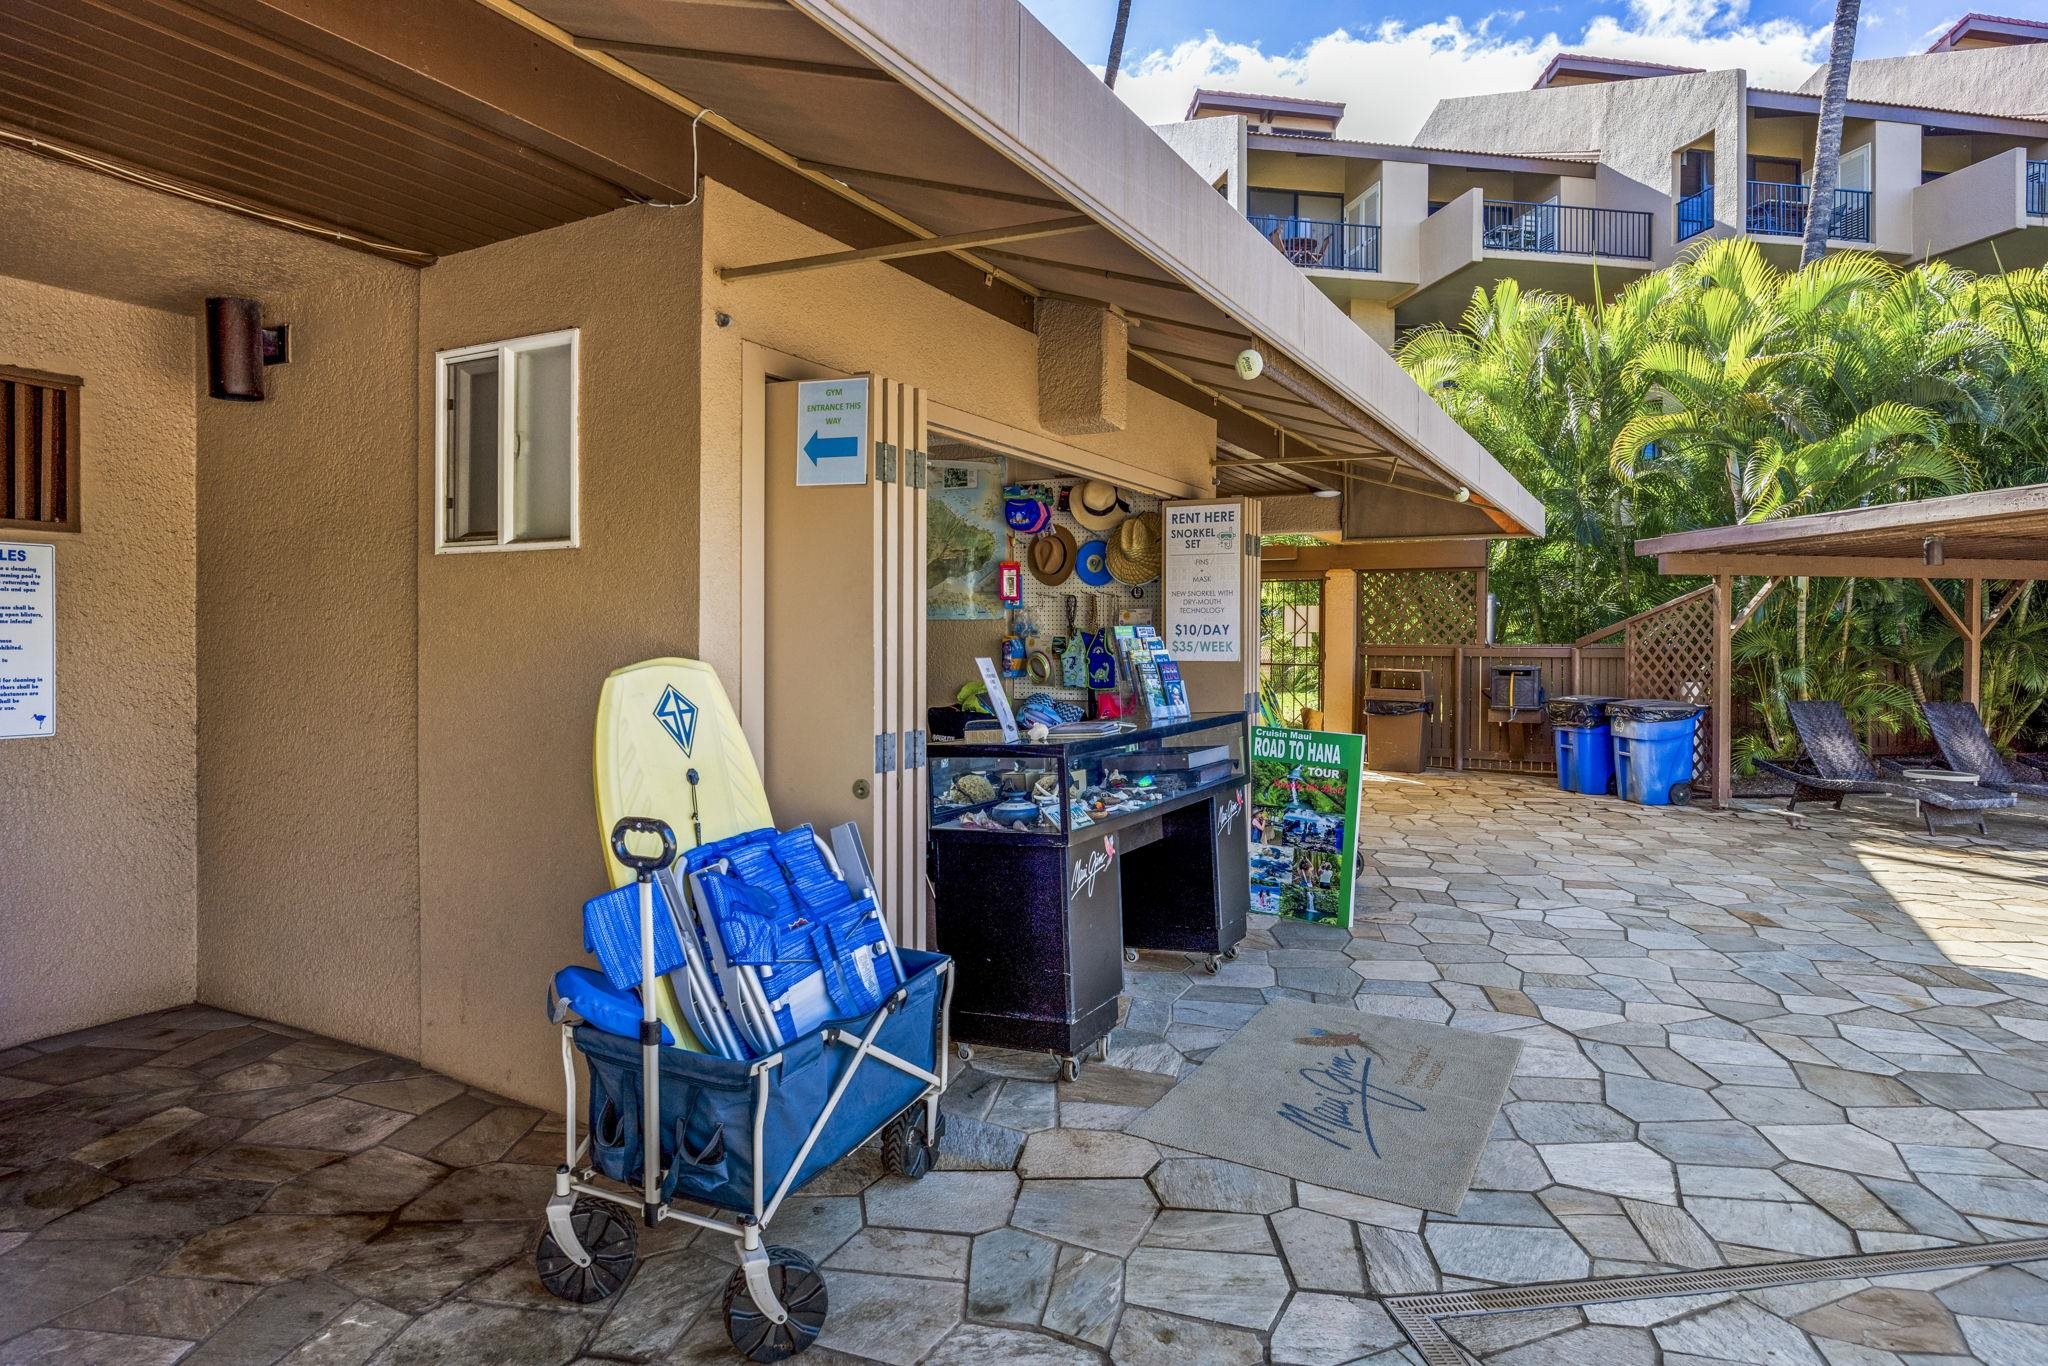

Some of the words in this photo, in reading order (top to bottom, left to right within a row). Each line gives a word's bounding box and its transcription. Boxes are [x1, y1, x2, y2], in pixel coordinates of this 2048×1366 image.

[825, 388, 843, 397] GYM
[807, 403, 844, 413] ENTRANCE
[845, 401, 862, 410] THIS
[825, 417, 842, 425] WAY
[1171, 512, 1201, 525] RENT
[1204, 510, 1235, 523] HERE
[1171, 528, 1216, 539] SNORKEL
[1185, 539, 1201, 549] SET
[1192, 575, 1212, 583] MASK
[1217, 589, 1234, 597] WITH
[1175, 623, 1230, 637] $10/DAY
[1172, 640, 1233, 653] $35/WEEK
[1255, 728, 1288, 738] Cruisin
[1290, 731, 1312, 741] Maui
[1254, 737, 1286, 759] ROAD
[1288, 740, 1305, 761] TO
[1307, 742, 1341, 765] HANA
[1307, 767, 1340, 779] TOUR
[1276, 1092, 1362, 1150] Maui
